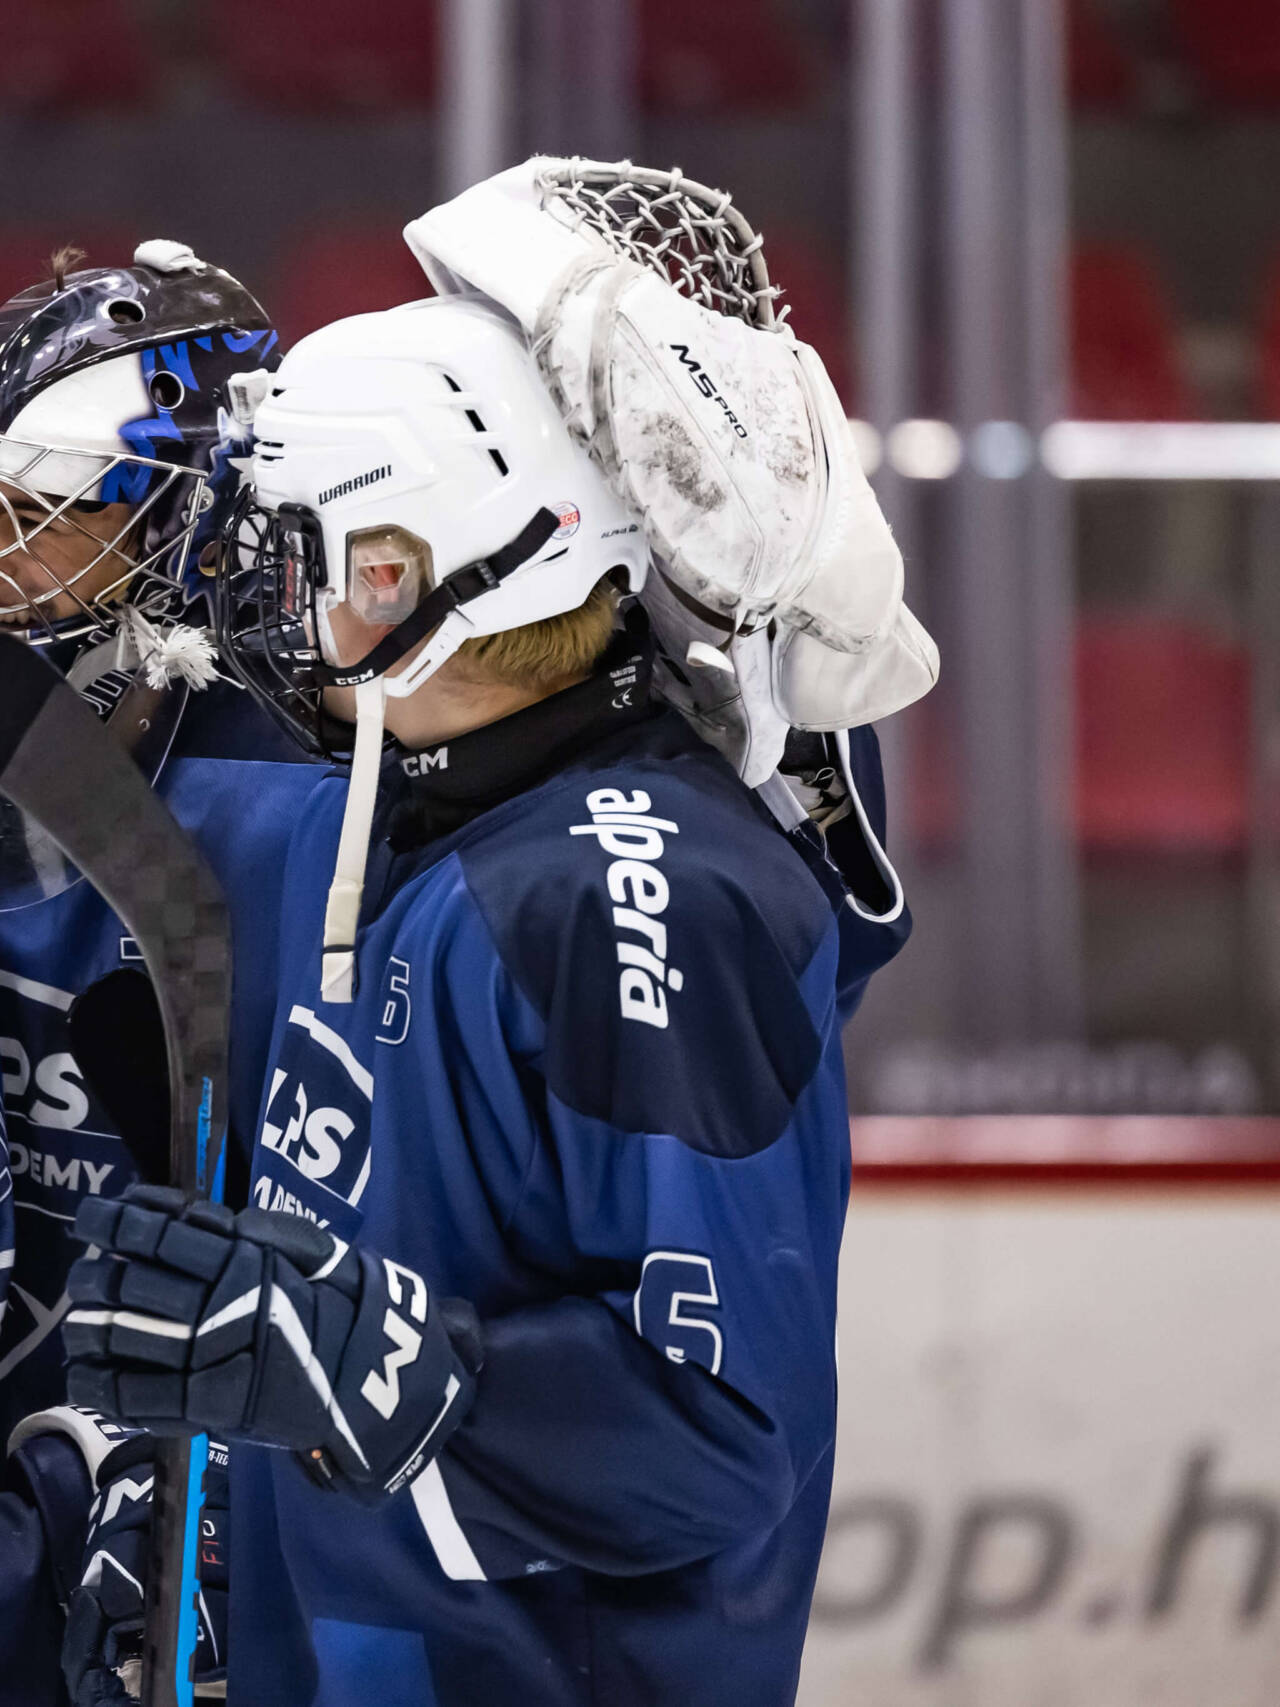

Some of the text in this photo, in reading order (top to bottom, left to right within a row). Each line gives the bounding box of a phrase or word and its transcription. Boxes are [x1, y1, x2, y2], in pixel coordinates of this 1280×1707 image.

[335, 668, 375, 686] CCM
[402, 747, 449, 777] CM
[569, 788, 684, 1029] alperia
[360, 1257, 428, 1421] CM
